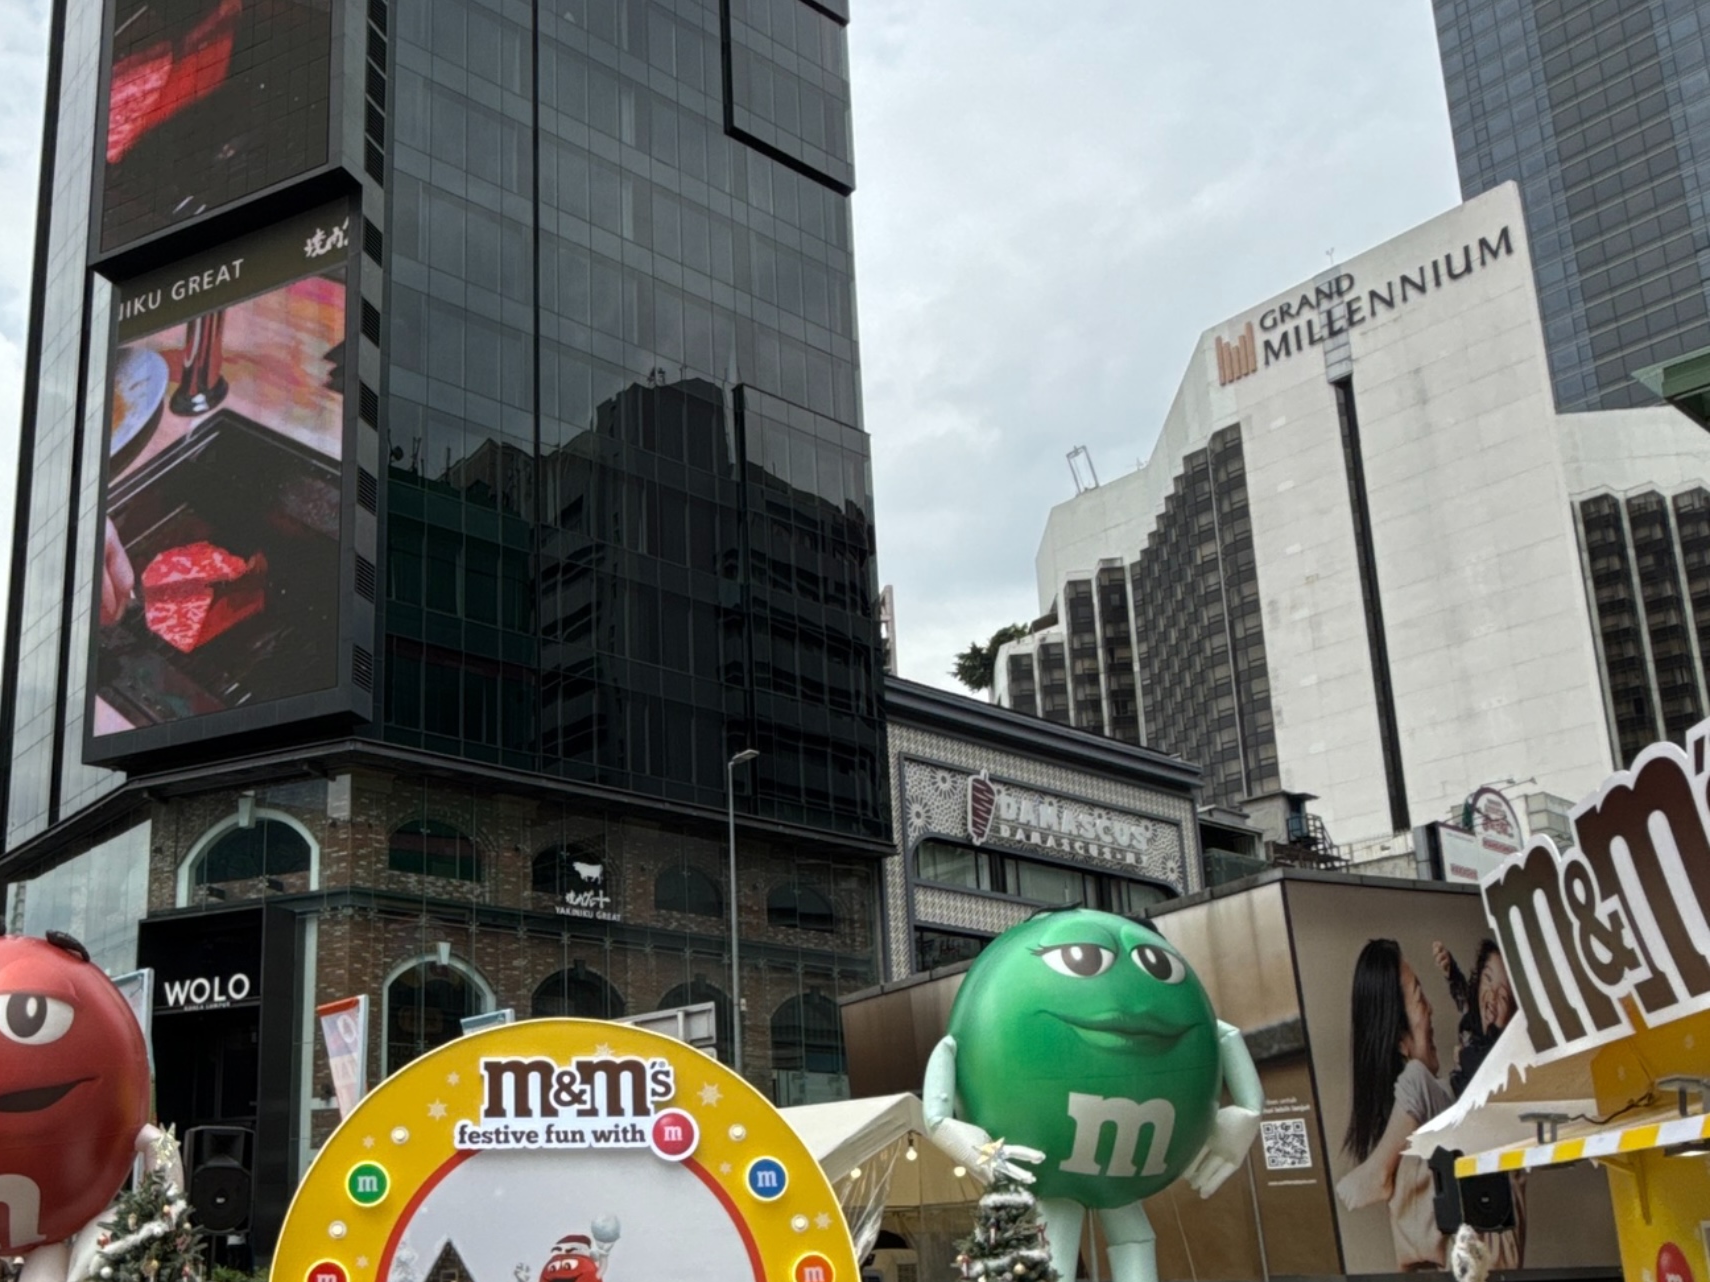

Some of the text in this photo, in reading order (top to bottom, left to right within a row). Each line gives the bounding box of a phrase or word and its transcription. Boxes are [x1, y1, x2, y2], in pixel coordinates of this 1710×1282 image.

[171, 259, 244, 300] GREAT
[1259, 271, 1357, 332] GRAND
[1262, 225, 1514, 367] MILLENNIUM
[998, 795, 1149, 849] DAMASCUS
[164, 971, 250, 1009] WOLO
[458, 1123, 684, 1147] festive fun with m
[1060, 1092, 1175, 1176] m
